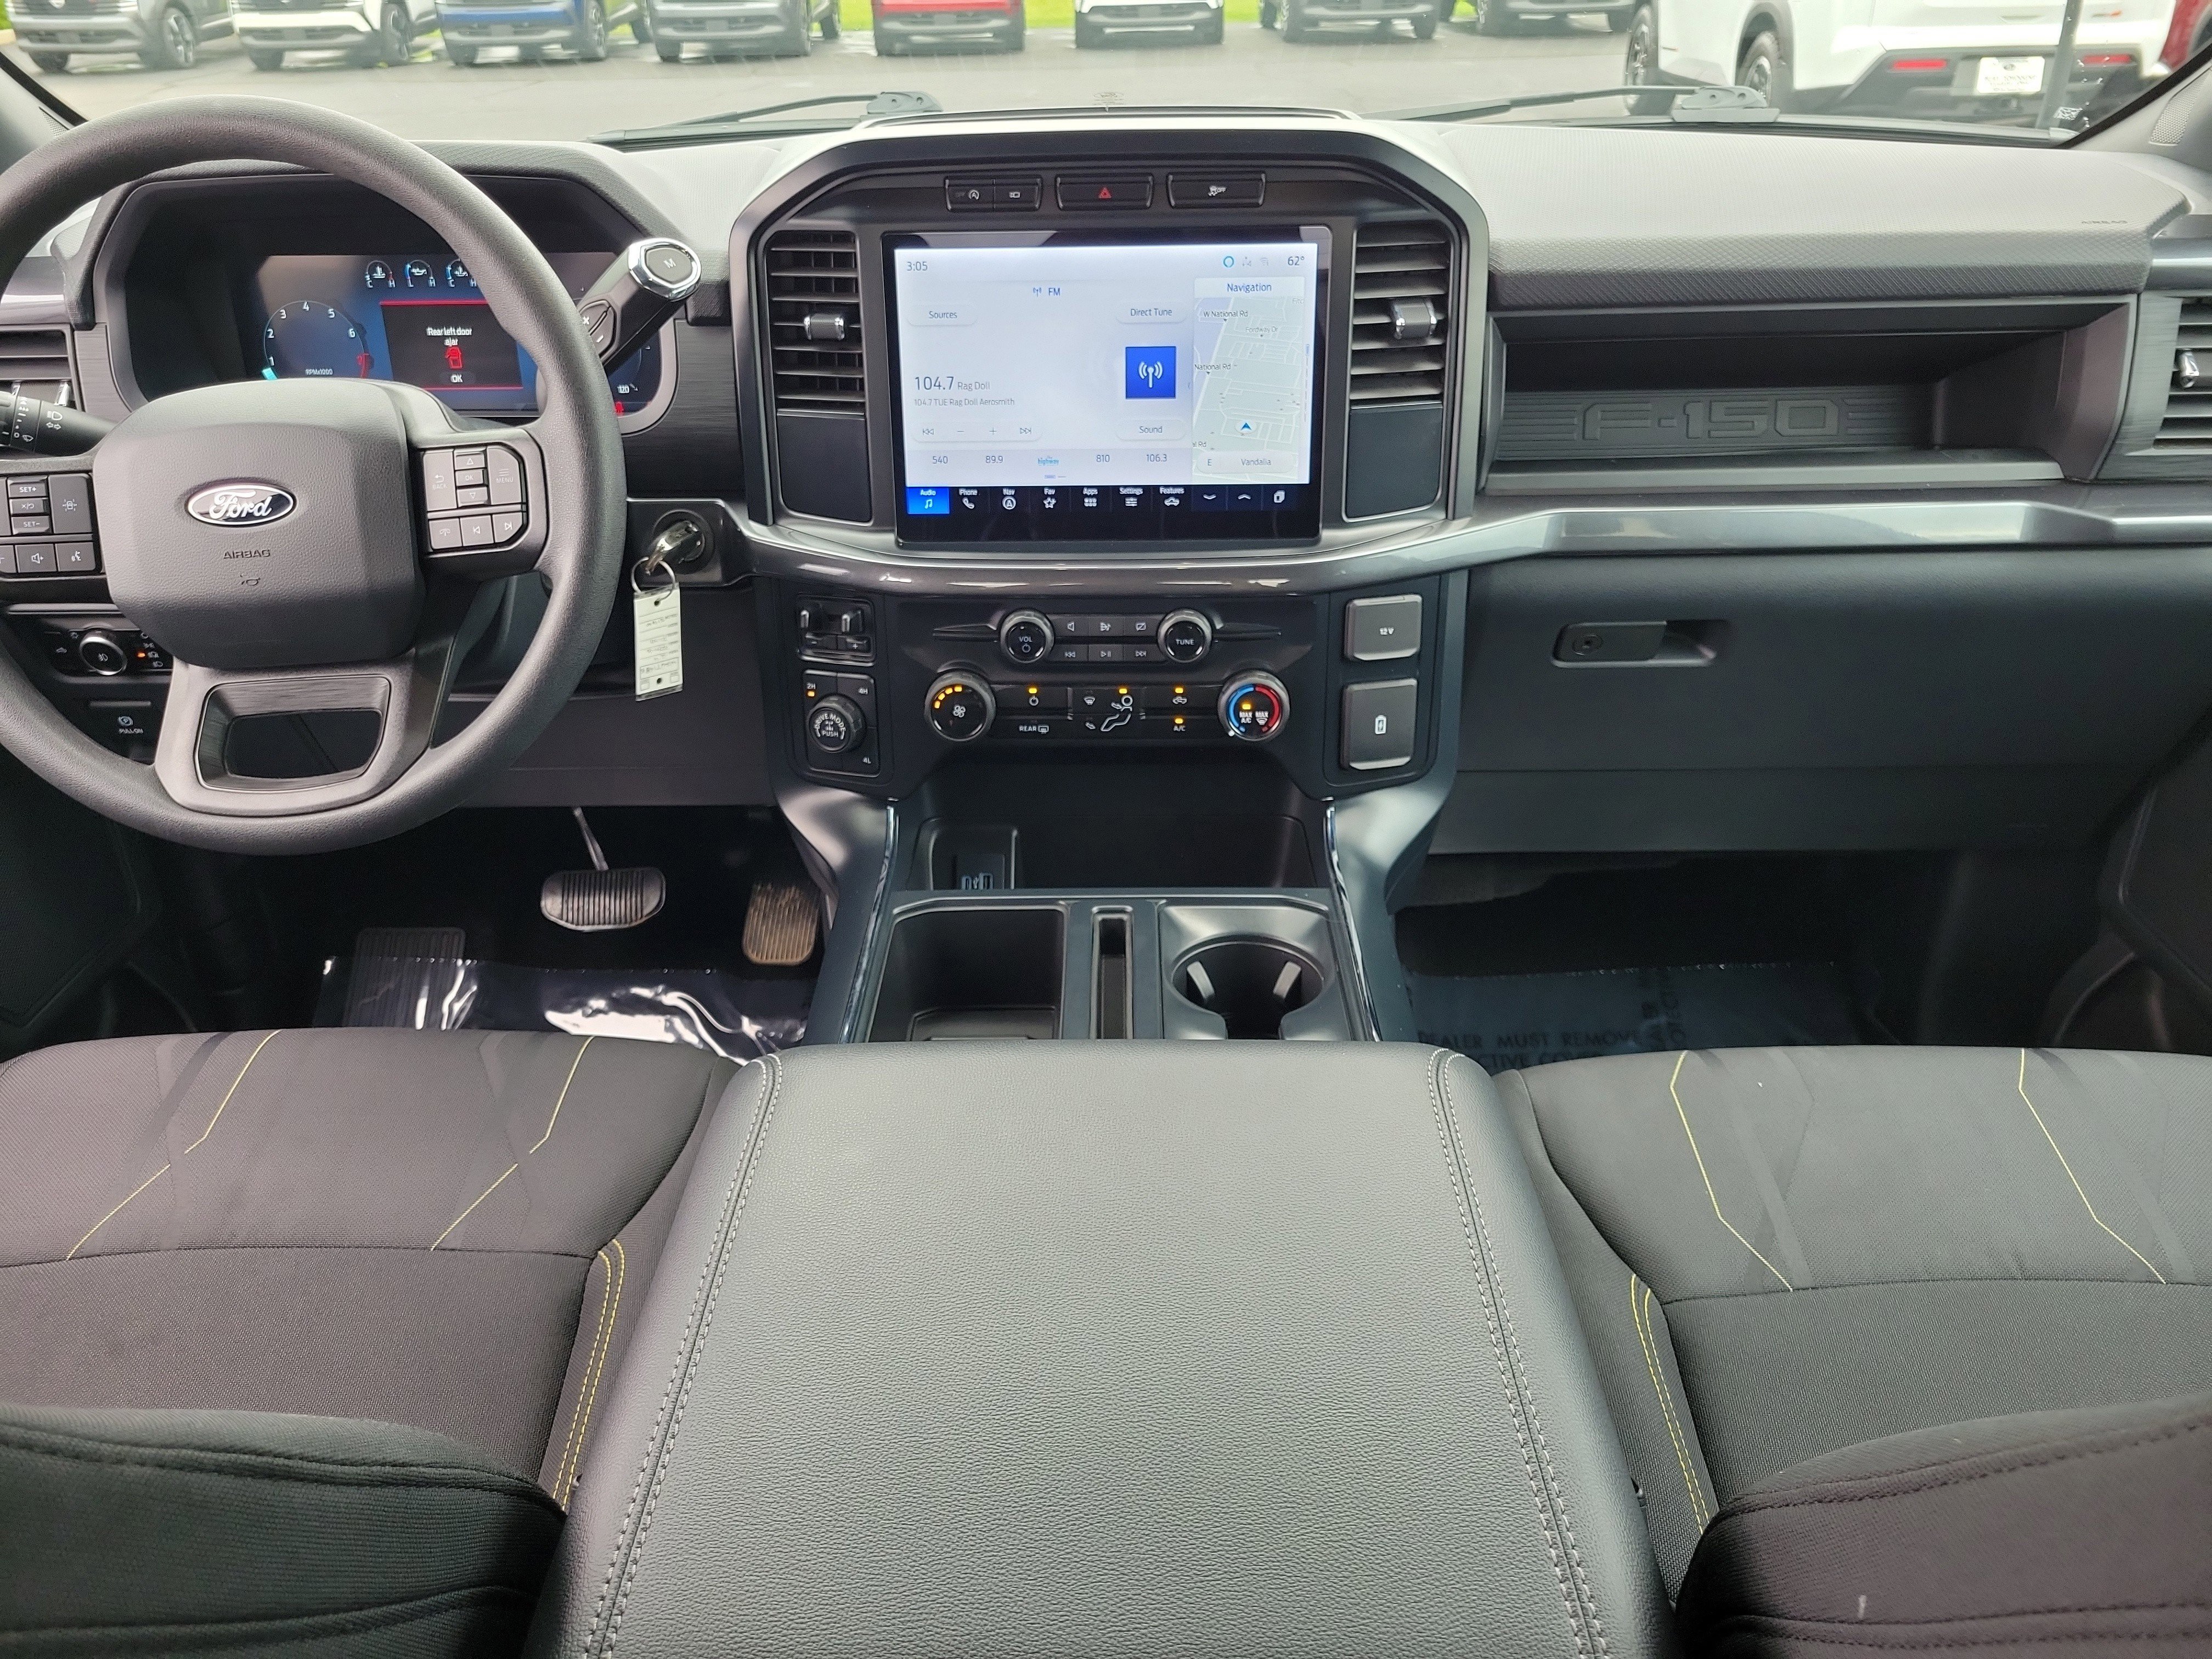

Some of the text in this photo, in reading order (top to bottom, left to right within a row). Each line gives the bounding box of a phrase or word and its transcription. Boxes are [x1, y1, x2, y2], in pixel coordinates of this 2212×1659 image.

[663, 258, 676, 268] M
[1288, 256, 1305, 266] 62°
[907, 261, 928, 271] 3:05
[388, 279, 396, 288] H
[407, 279, 414, 287] L
[428, 279, 436, 287] H
[1048, 287, 1060, 296] FM
[1227, 283, 1272, 293] Navigation
[302, 302, 310, 311] 4
[279, 309, 287, 319] 3
[328, 308, 335, 318] 5
[929, 311, 957, 319] Sources
[1131, 308, 1172, 317] Direct Tune
[267, 329, 274, 338] 2
[348, 328, 356, 338] 6
[427, 326, 472, 336] Rear left door
[444, 337, 458, 347] ajar
[268, 357, 274, 366] 1
[451, 374, 463, 383] OK
[915, 376, 990, 392] 104.7 Rag Doll
[950, 399, 962, 407] Rag
[980, 398, 1014, 406] Aerosmith
[1583, 399, 1839, 440] F-150
[1139, 426, 1163, 434] Sound
[932, 456, 948, 464] 540
[985, 455, 1003, 464] 89.9
[1146, 454, 1167, 462] 106.3
[1083, 487, 1098, 495] Apps
[1119, 487, 1143, 495] Settings
[209, 490, 272, 519] Ford
[223, 549, 271, 559] AIRBAG
[814, 713, 846, 731] DRIVE MODE
[1498, 1032, 1549, 1048] MUST
